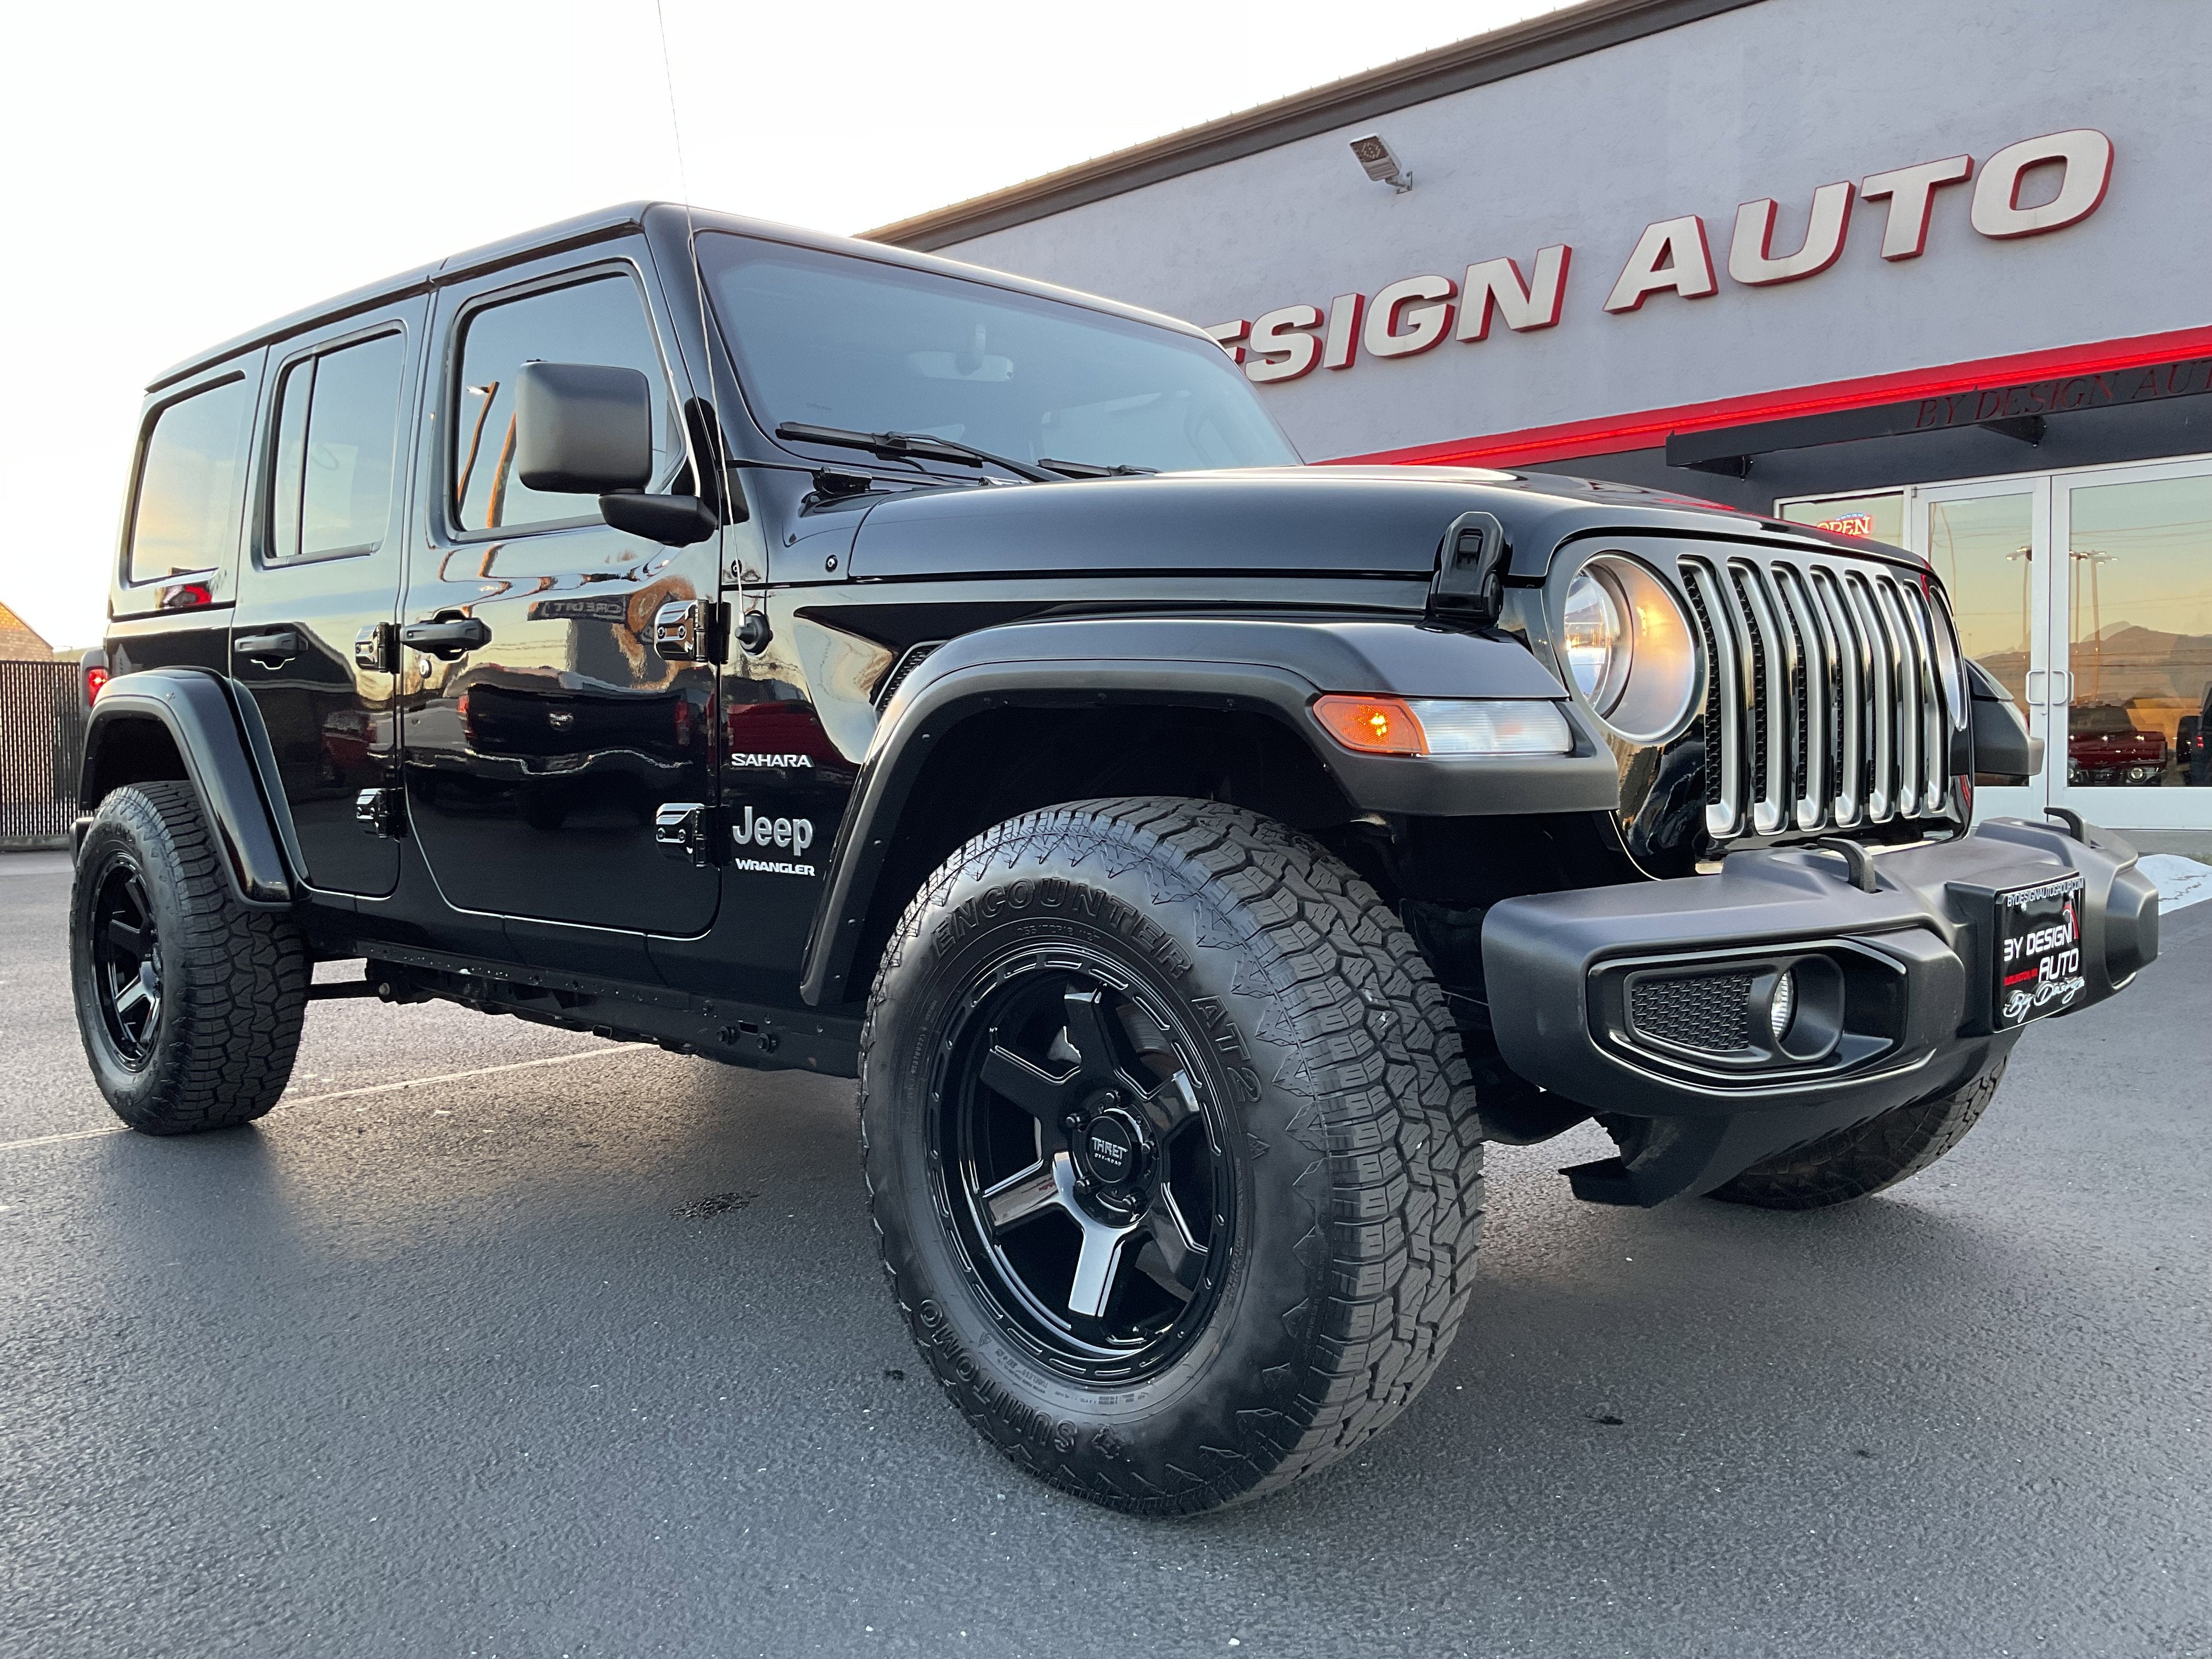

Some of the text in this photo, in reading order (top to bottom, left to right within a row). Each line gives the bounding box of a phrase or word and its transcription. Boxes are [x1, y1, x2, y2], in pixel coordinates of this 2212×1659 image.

[1603, 128, 2115, 315] AUTO
[1915, 394, 1966, 428] BY
[1975, 373, 2120, 420] DESIGN
[731, 753, 815, 768] SAHARA
[732, 806, 813, 856] Jeep
[735, 858, 815, 876] WRANGLER
[933, 877, 1193, 981] ENCOUNTER
[2004, 923, 2072, 962] BY DESIGN
[2038, 947, 2079, 983] AUTO
[1091, 1137, 1127, 1160] THRET
[919, 1299, 1078, 1453] SUMITOMO
